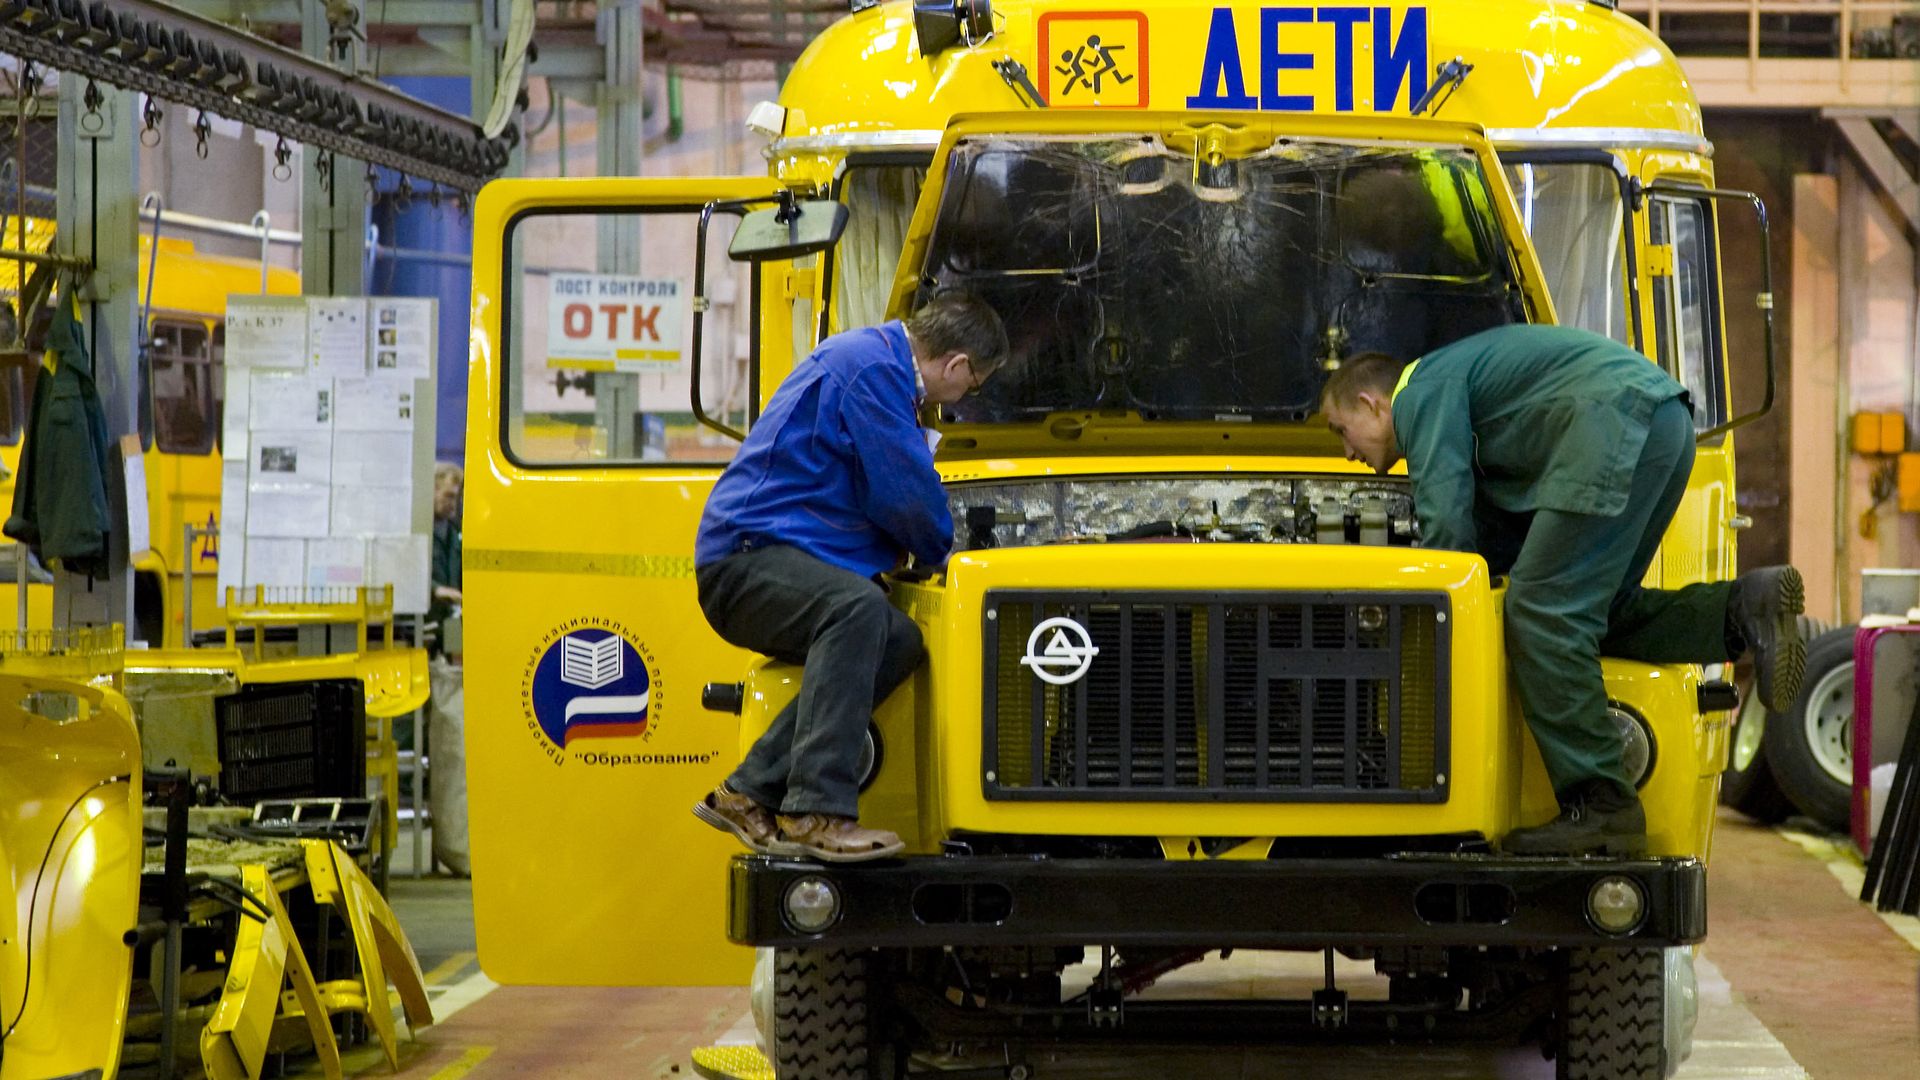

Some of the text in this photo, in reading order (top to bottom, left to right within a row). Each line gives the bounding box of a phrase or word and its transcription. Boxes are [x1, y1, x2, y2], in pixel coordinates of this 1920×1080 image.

[1186, 7, 1427, 111] ДЕТИ
[555, 279, 677, 296] ПОСТ КОНТРОЛЯ
[563, 303, 661, 341] ОТК
[521, 616, 663, 766] Приоритетные национальные проекты
